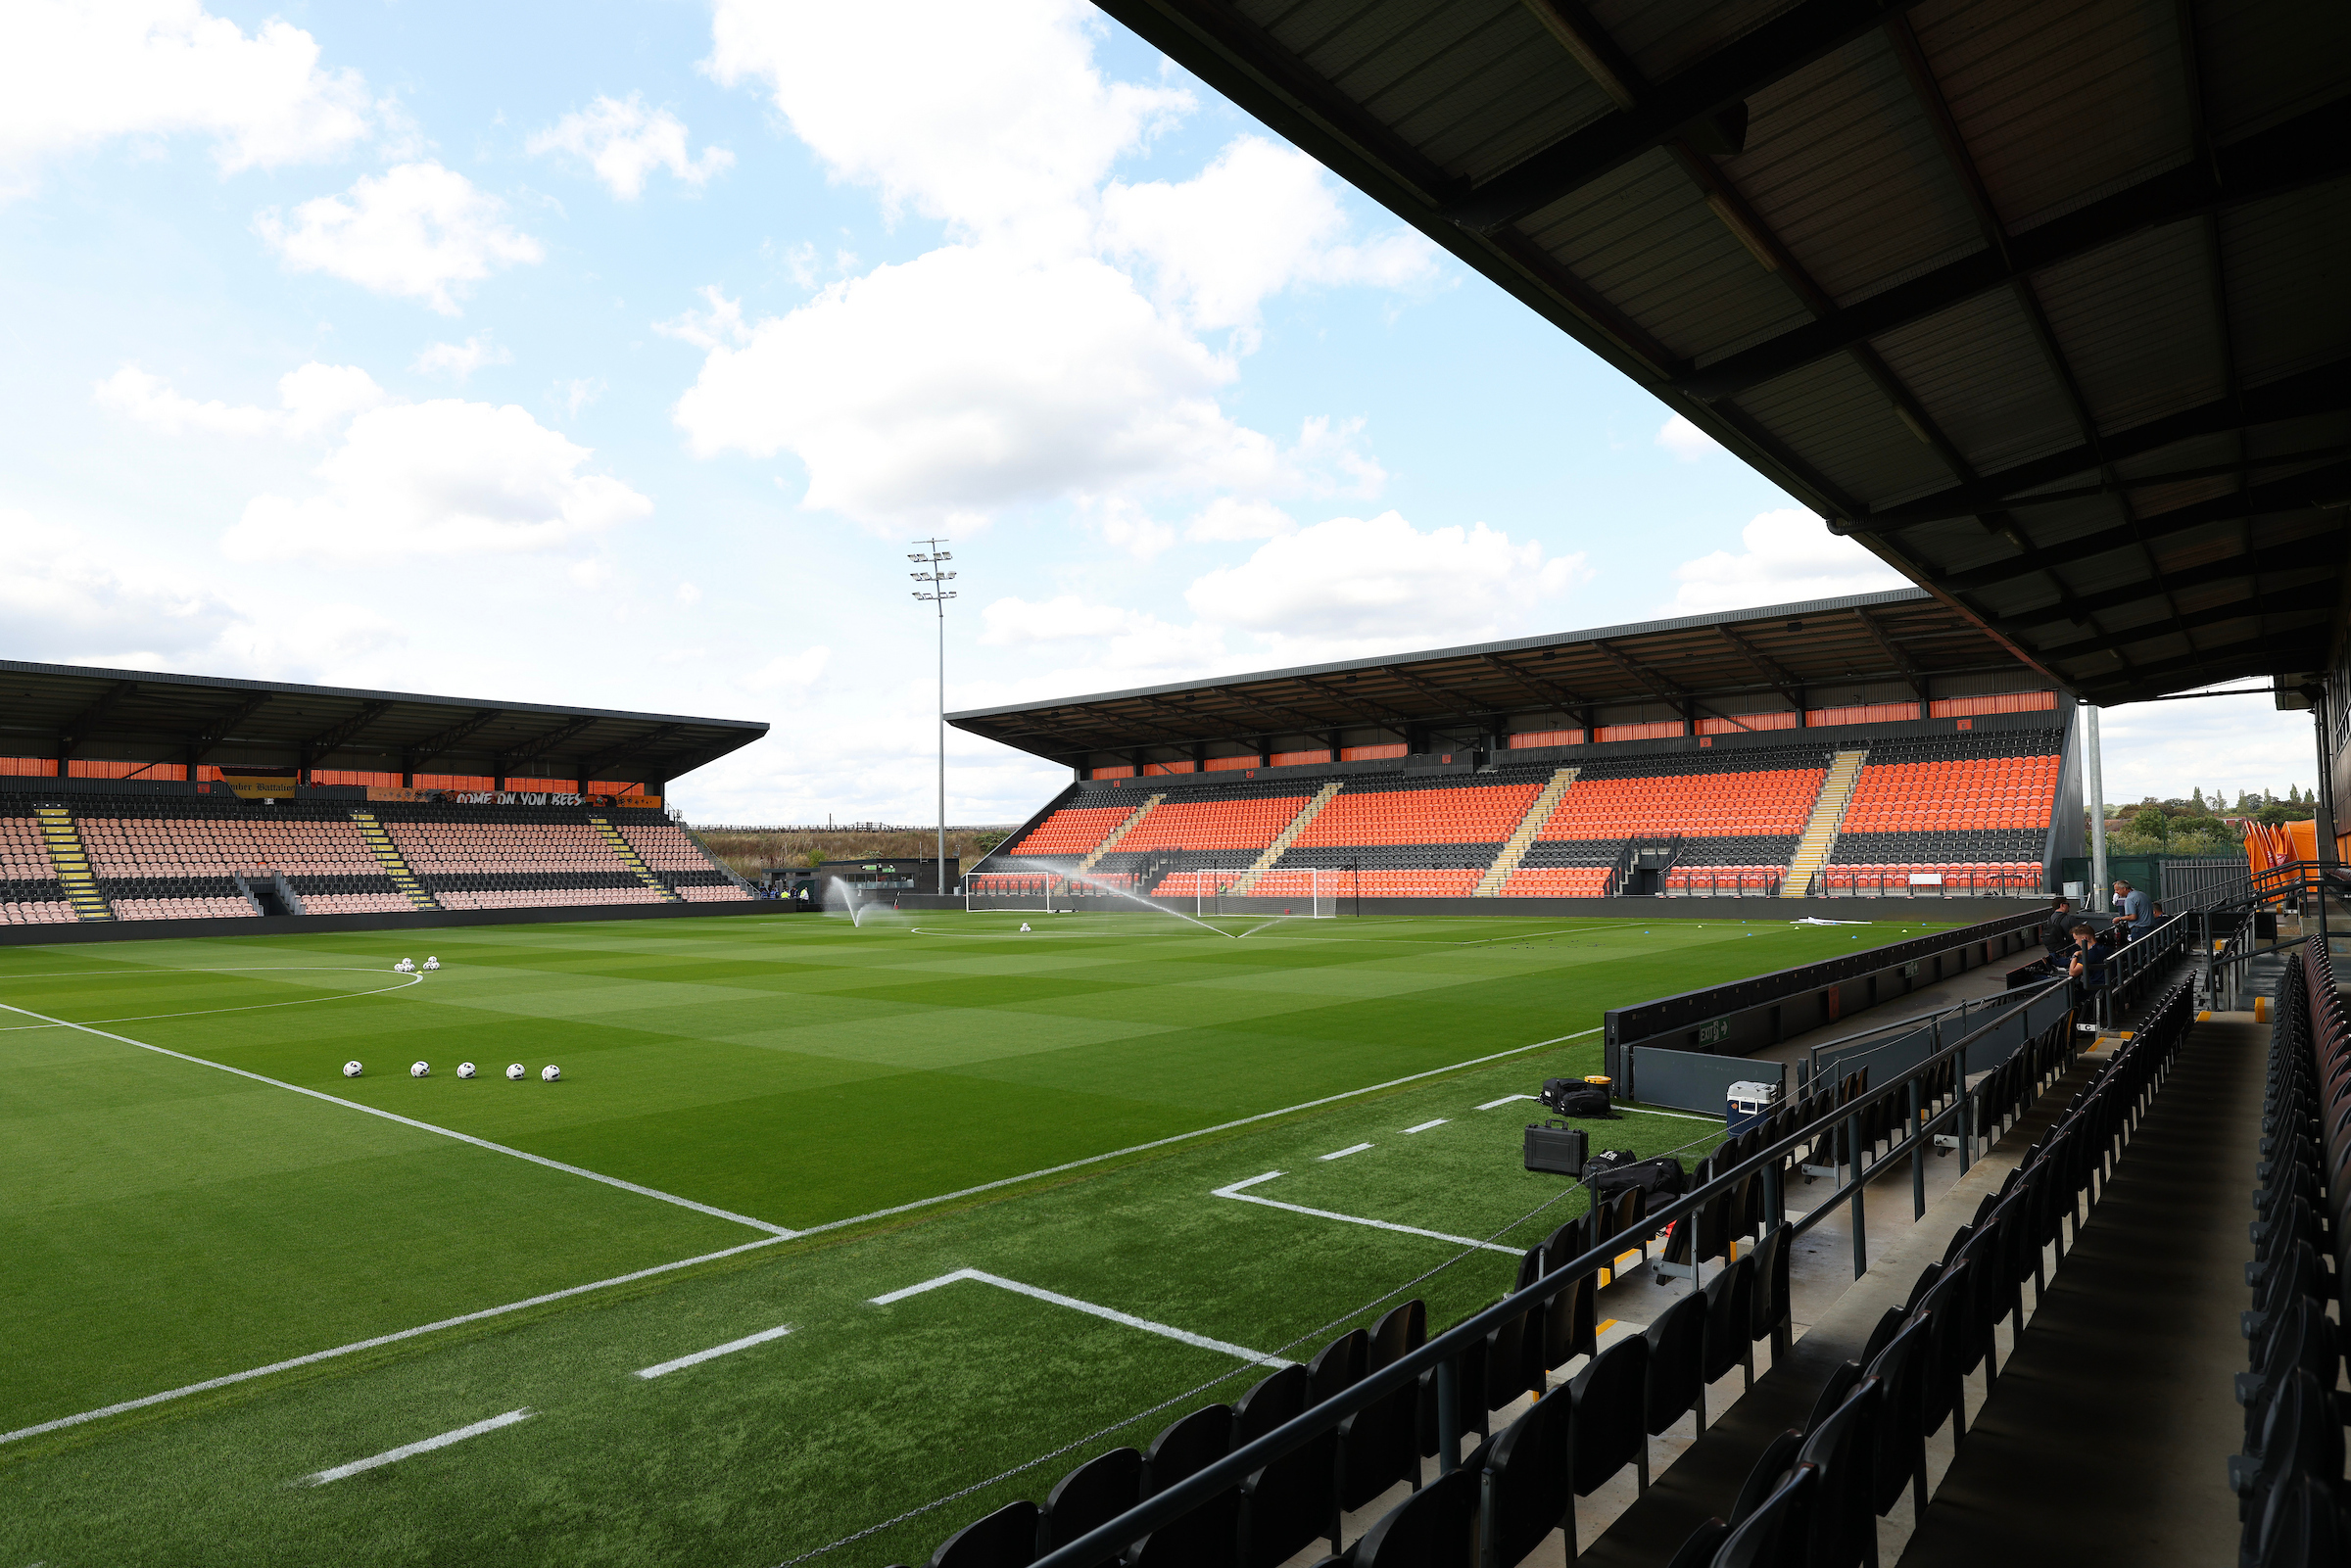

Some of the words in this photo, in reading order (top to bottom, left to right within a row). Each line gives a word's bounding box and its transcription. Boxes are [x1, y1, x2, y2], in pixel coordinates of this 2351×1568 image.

[230, 783, 252, 791] mber
[456, 791, 493, 804] COME
[497, 791, 516, 805] ON
[520, 791, 548, 806] YOU
[551, 792, 582, 806] BEES
[1701, 1025, 1713, 1041] EXIT
